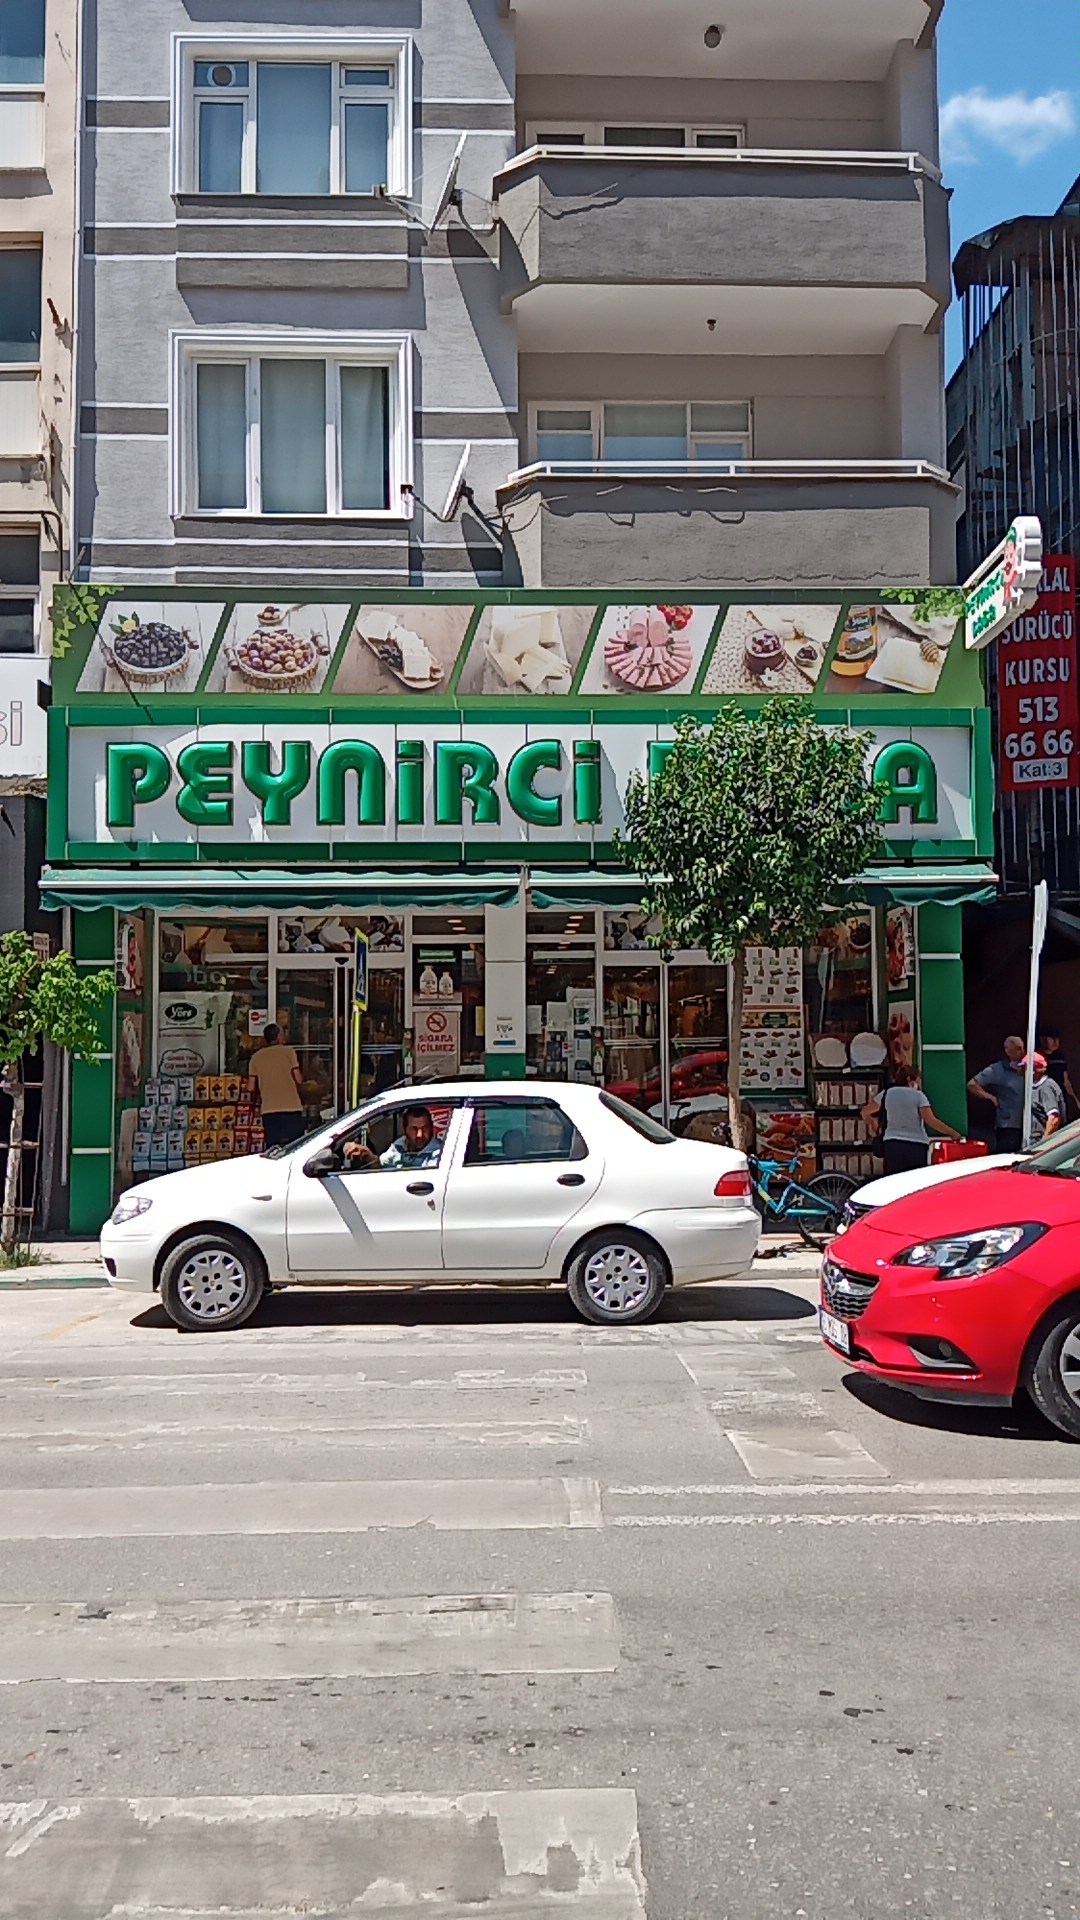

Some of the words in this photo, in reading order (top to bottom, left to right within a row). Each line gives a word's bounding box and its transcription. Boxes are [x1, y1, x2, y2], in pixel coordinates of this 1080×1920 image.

[1038, 566, 1071, 592] LAL
[1005, 657, 1070, 687] KURSU
[1018, 696, 1059, 724] 513
[1004, 731, 1037, 759] 66
[1043, 729, 1074, 755] 66
[1018, 761, 1063, 778] Kat:3
[417, 1043, 455, 1053] İÇİLMEZ
[418, 1033, 453, 1043] SİGARA
